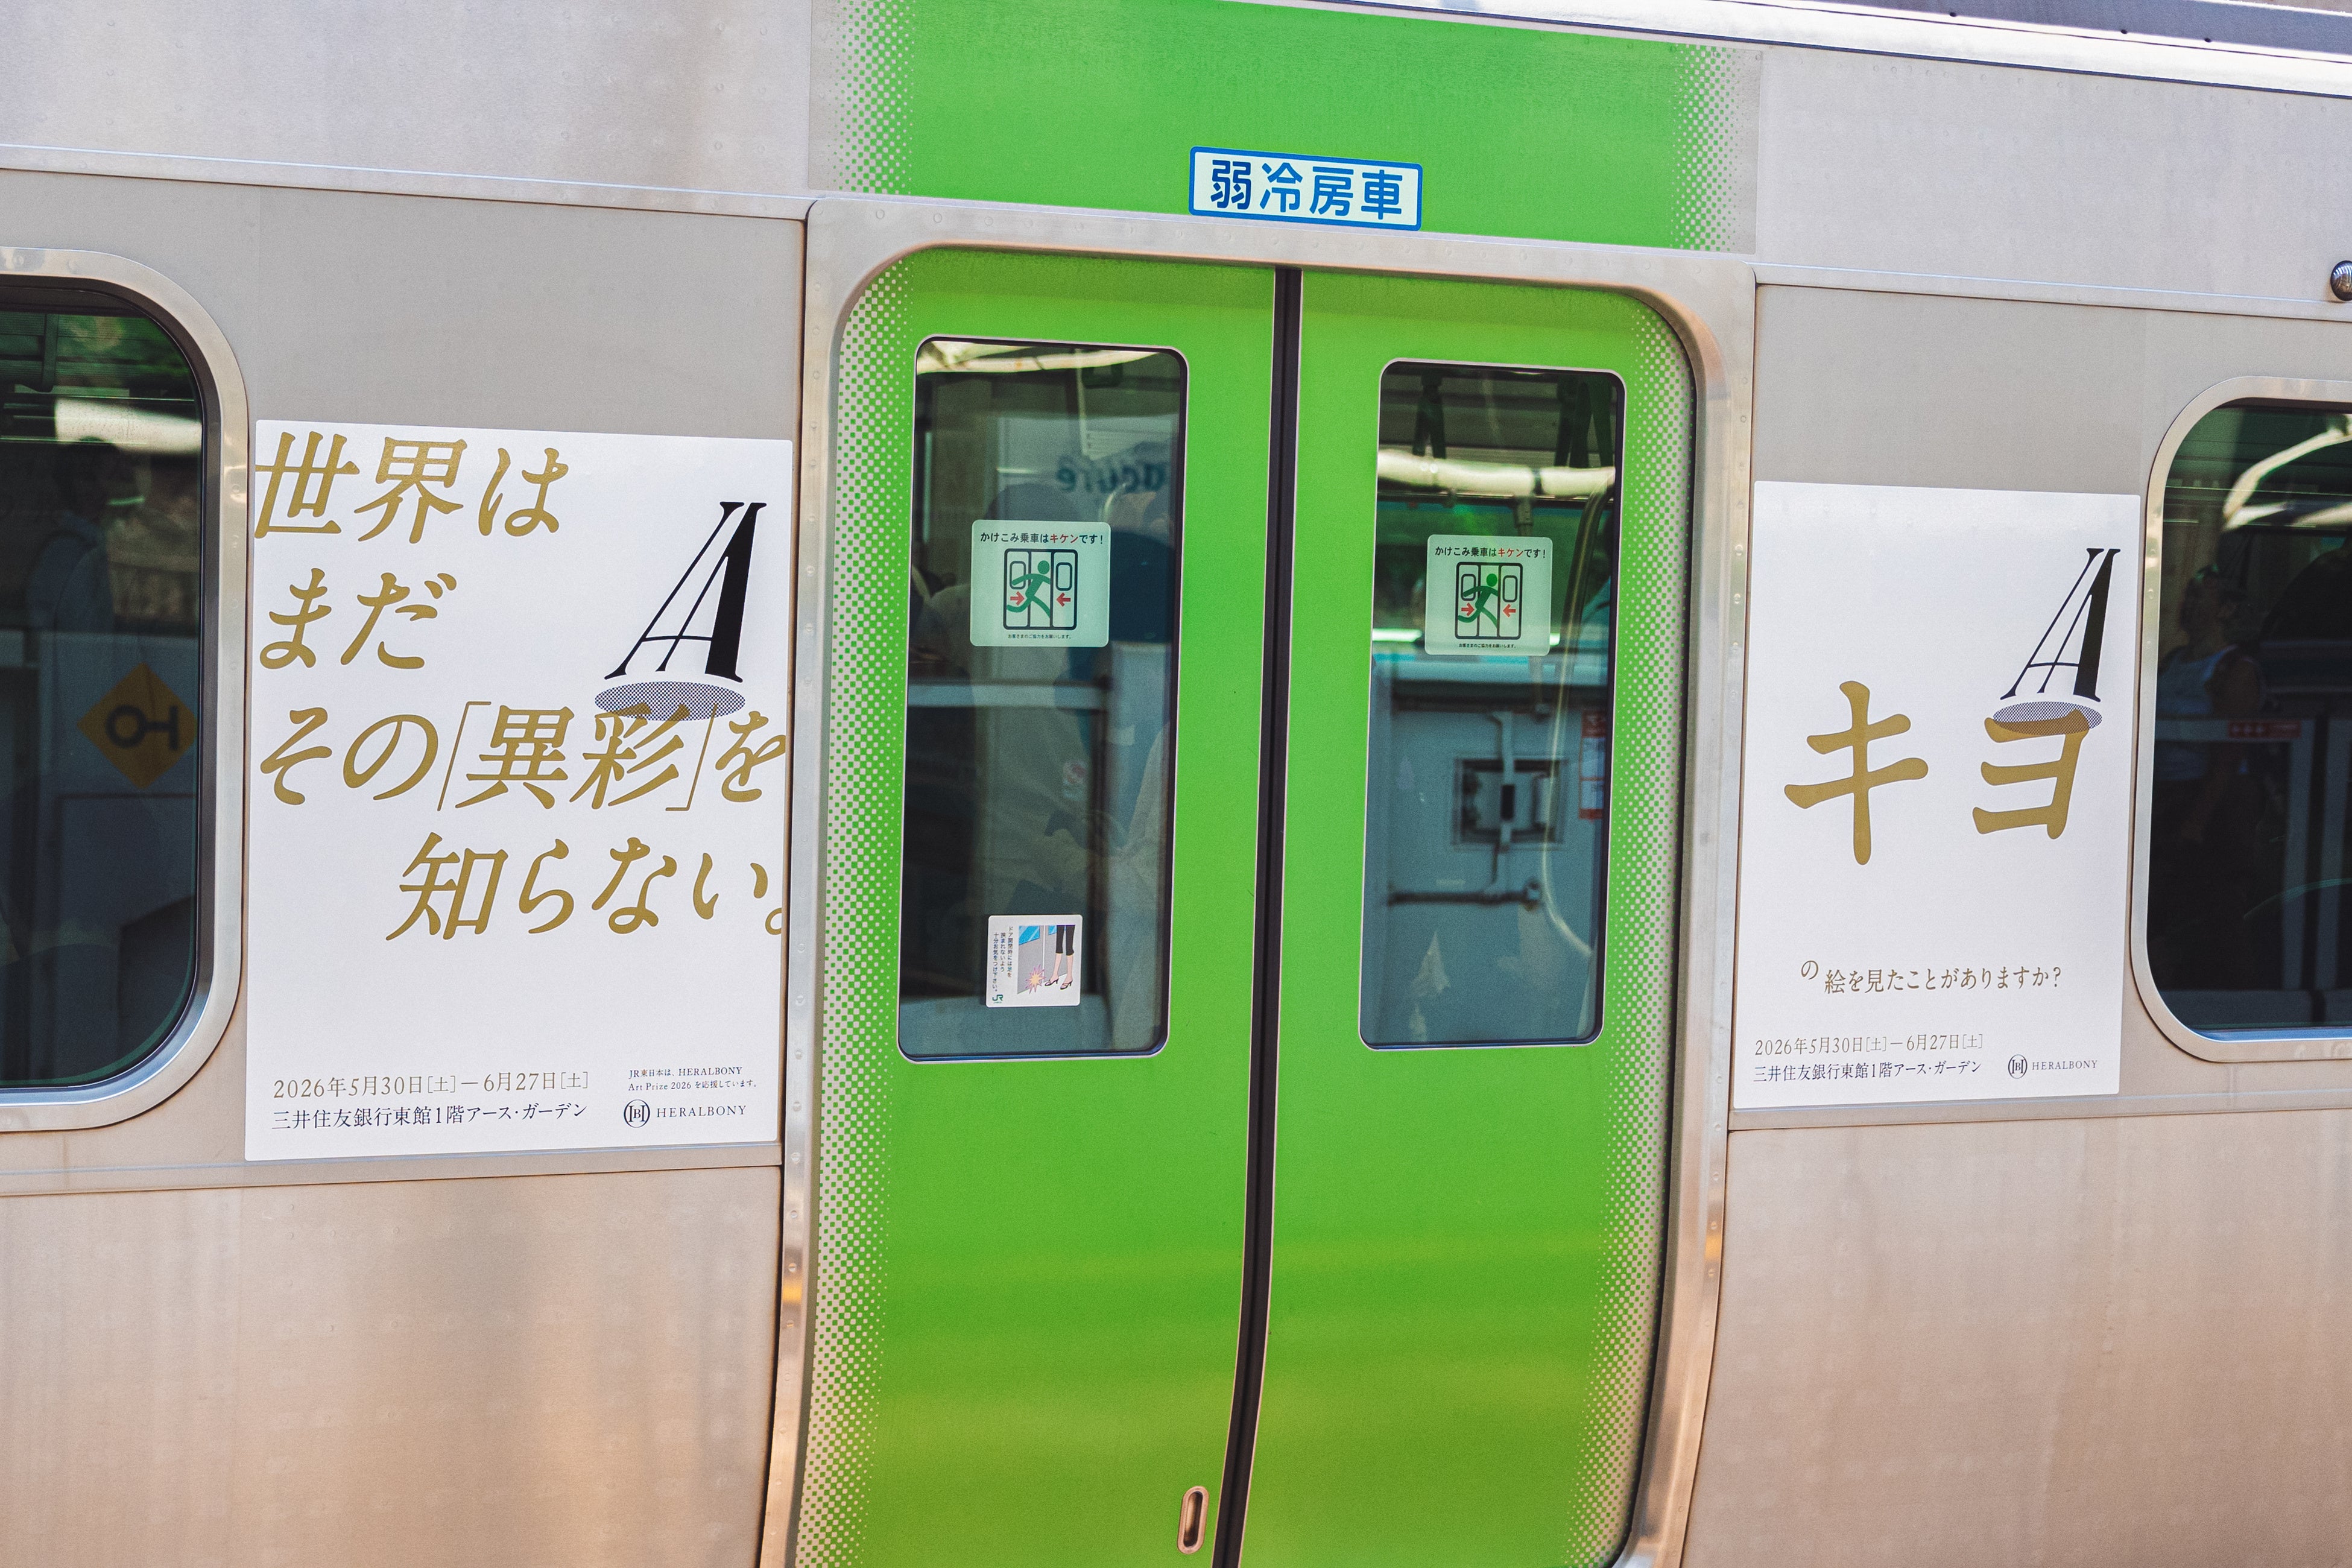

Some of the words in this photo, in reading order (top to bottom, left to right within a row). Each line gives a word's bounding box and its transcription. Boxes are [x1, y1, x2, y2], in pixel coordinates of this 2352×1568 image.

[1210, 159, 1403, 220] 弱冷房車
[254, 431, 569, 544] 世界は
[260, 567, 457, 669] まだ
[261, 701, 786, 812] その「異彩」を
[628, 1069, 674, 1080] JR東日本は、
[678, 1066, 743, 1076] HERALBONY
[2031, 1060, 2098, 1070] HERALBONY
[671, 1081, 692, 1090] 2026
[695, 1080, 757, 1089] を応援しています。
[657, 1105, 747, 1118] HERALBONY
